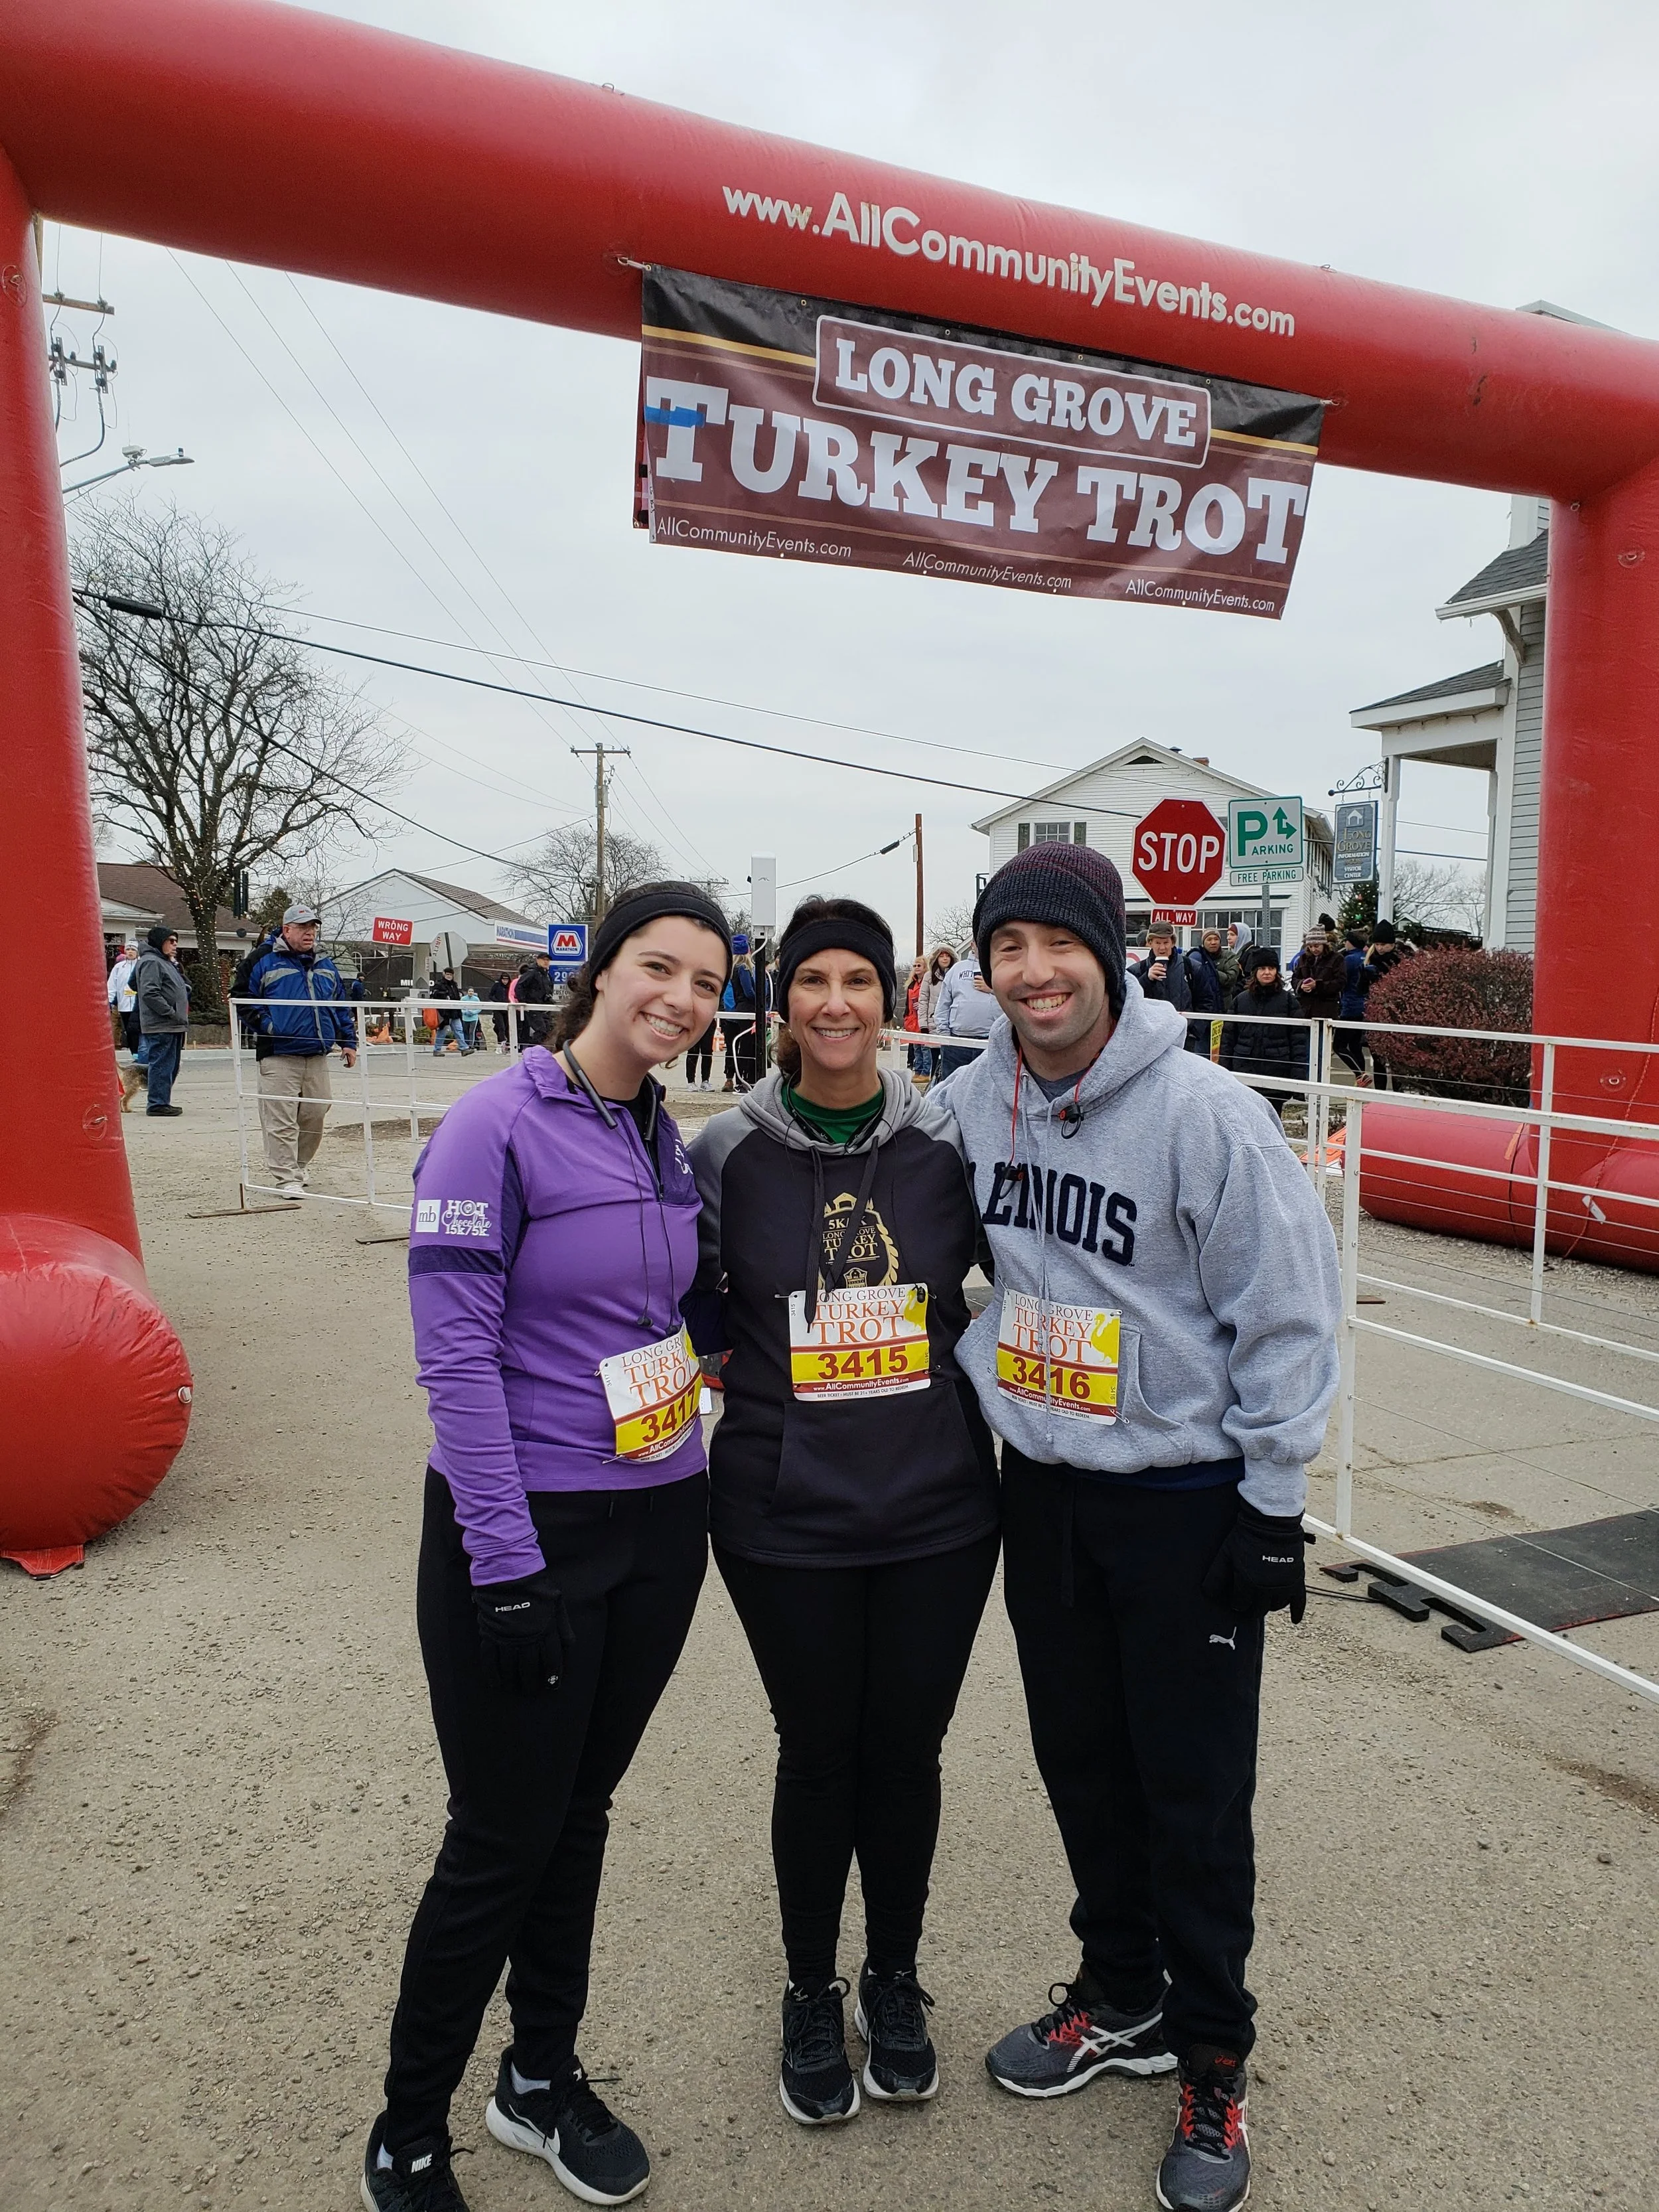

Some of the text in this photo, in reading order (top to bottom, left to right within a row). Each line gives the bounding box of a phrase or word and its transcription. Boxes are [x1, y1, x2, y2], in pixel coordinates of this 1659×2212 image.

[722, 185, 1295, 337] www.AllCommunityEvents.com
[835, 338, 1198, 448] LONG GROVE
[645, 375, 1308, 564] TURKEY TROT
[657, 516, 852, 557] AllCommunityEvents.com
[902, 551, 1072, 589] AllCommunityEvents.com
[1125, 579, 1275, 611] AllCommunityEvents.com
[1138, 831, 1220, 873] STOP
[1238, 869, 1296, 883] FREE PARKING
[378, 920, 409, 932] WRONG
[1155, 911, 1193, 923] ALL WAY
[382, 931, 402, 941] WAY
[419, 1206, 437, 1222] mb
[441, 1209, 492, 1228] Chocolate
[447, 1200, 489, 1217] HOT
[857, 1286, 906, 1301] GROVE
[815, 1298, 904, 1321] TURKEY
[1048, 1303, 1094, 1321] GROVE
[812, 1315, 904, 1345] TROT
[1015, 1306, 1092, 1339] TURKEY
[621, 1345, 663, 1368] LONG
[817, 1345, 908, 1380] 3415
[813, 1376, 909, 1392] www.AllCommunityEvents.com
[1012, 1356, 1090, 1400] 3416
[640, 1384, 696, 1443] 3417
[495, 1601, 531, 1613] HEAD
[411, 2153, 433, 2174] NIKE
